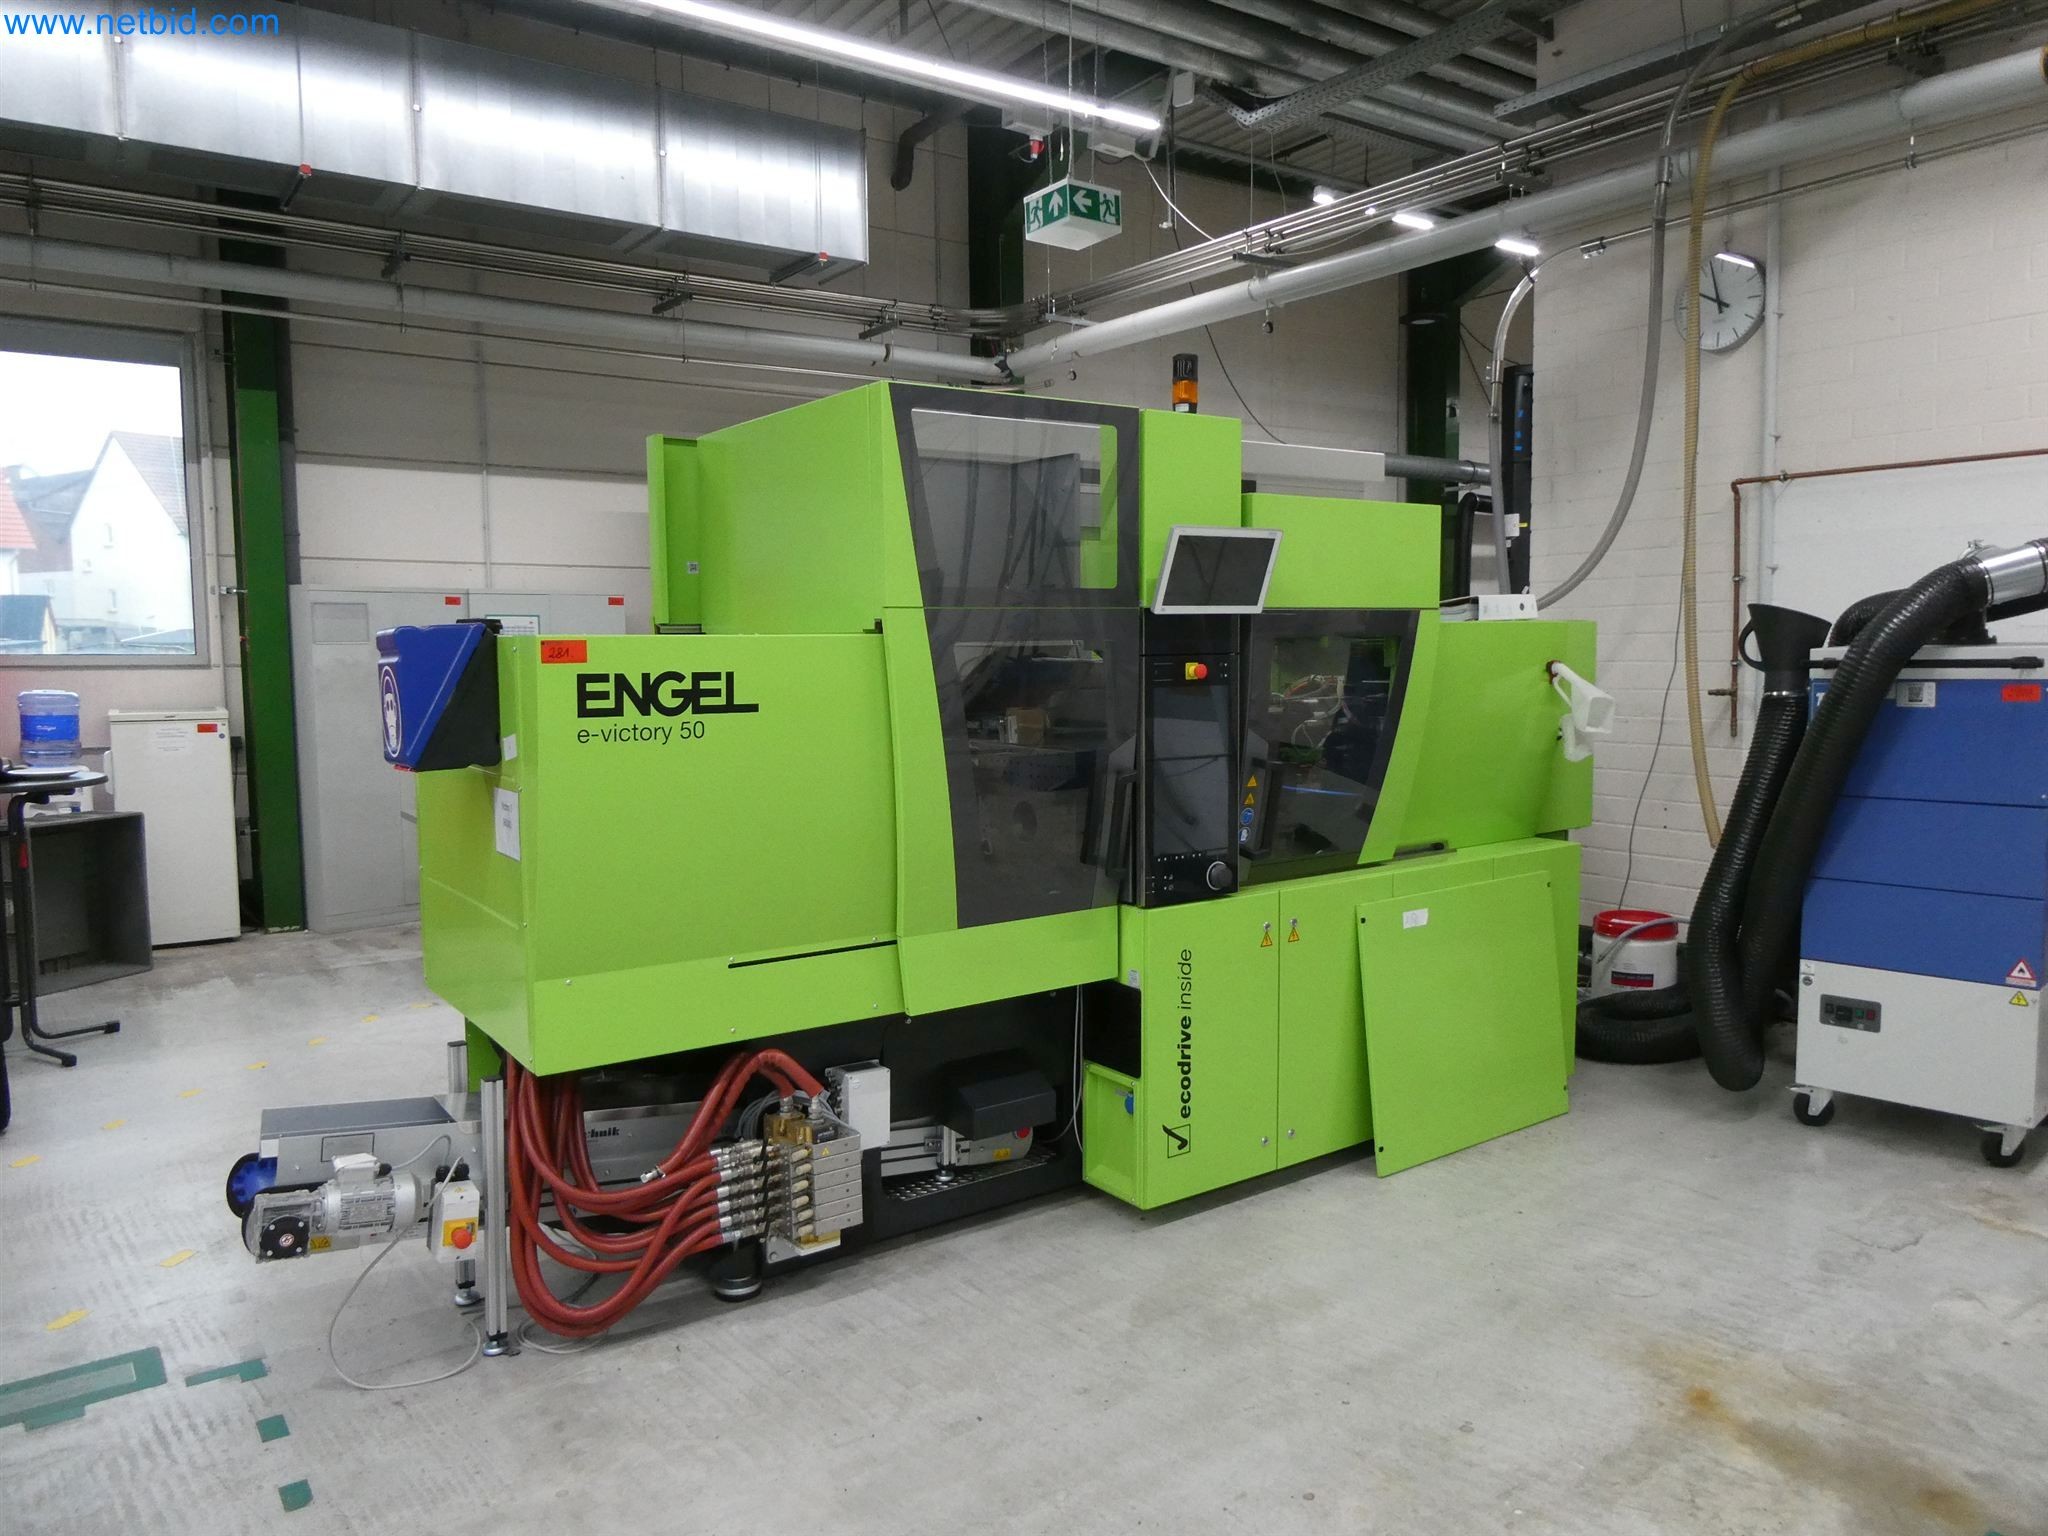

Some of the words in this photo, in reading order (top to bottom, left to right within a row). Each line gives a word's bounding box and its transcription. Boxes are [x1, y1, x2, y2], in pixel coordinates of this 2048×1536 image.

[576, 671, 759, 718] ENGEL
[577, 723, 673, 745] e-victory
[680, 720, 705, 739] 50
[1177, 949, 1192, 1010] inside
[1177, 1015, 1192, 1119] ecodrive
